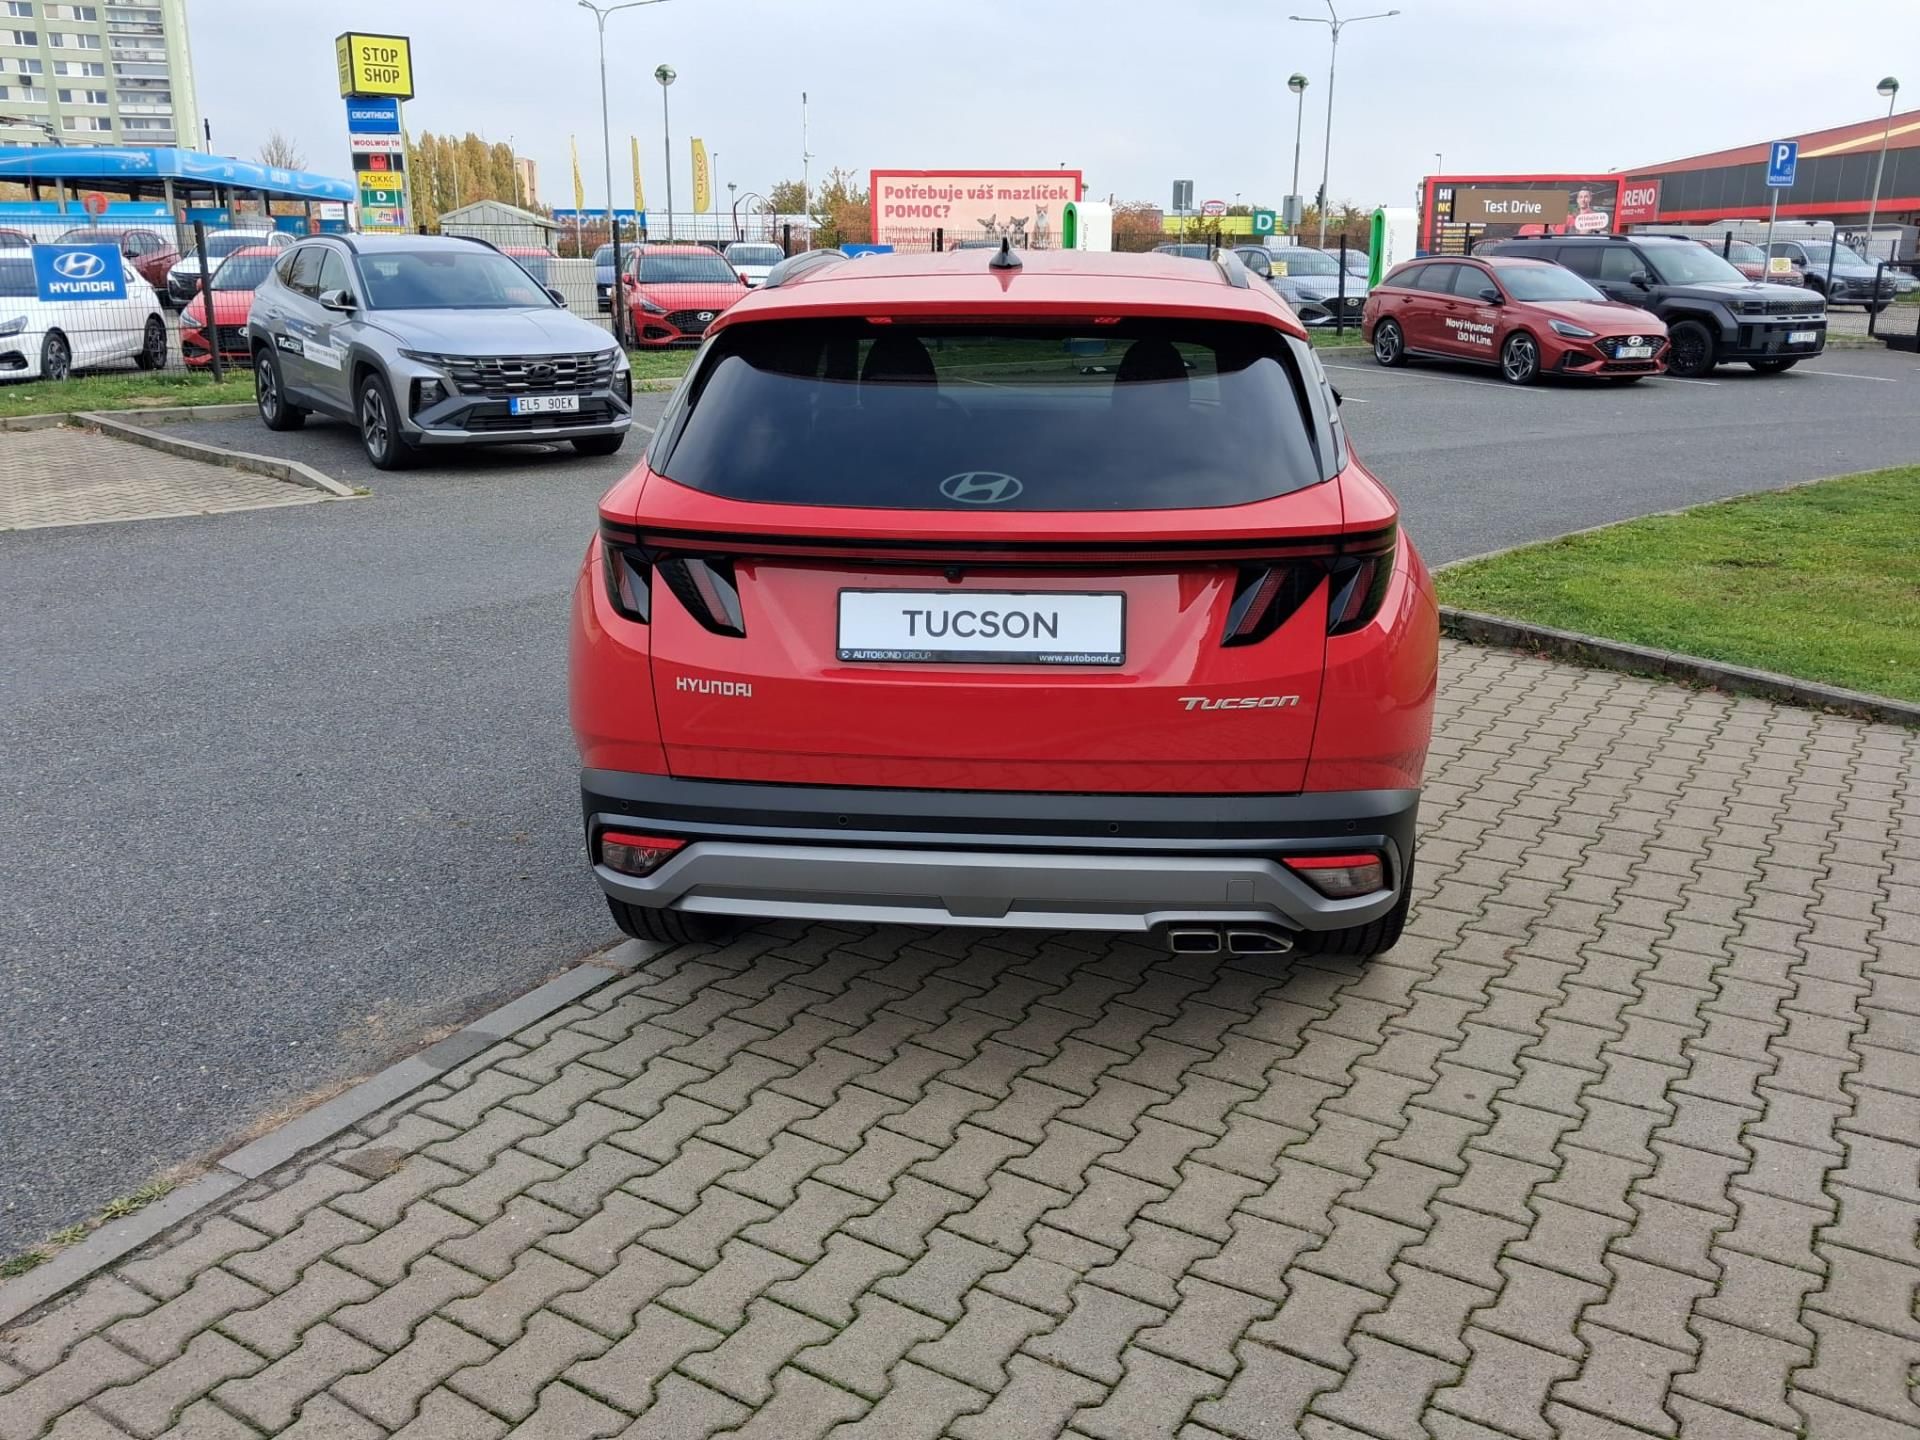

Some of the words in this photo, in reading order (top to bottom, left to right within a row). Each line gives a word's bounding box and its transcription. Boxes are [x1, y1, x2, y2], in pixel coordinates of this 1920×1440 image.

[362, 46, 399, 63] STOP
[364, 67, 400, 83] SHOP
[351, 111, 394, 119] DECATHLON
[1776, 144, 1790, 170] P
[376, 191, 387, 201] D
[884, 184, 963, 203] Potřebuje
[967, 184, 994, 200] váš
[998, 185, 1068, 200] mazlíček
[1622, 188, 1656, 206] RENO
[884, 204, 951, 218] POMOC?
[1484, 200, 1507, 213] Test
[1511, 200, 1542, 213] Drive
[1256, 214, 1273, 230] D
[49, 281, 115, 293] HYUNDAI
[1446, 318, 1464, 330] Nový
[1464, 321, 1494, 333] Hyundai
[1457, 331, 1468, 341] i30
[1469, 335, 1475, 343] N
[520, 399, 540, 411] EL5
[548, 397, 573, 409] 90EK
[902, 609, 1058, 639] TUCSON
[853, 650, 901, 660] AUTOBOND
[903, 651, 932, 660] GROUP
[1038, 654, 1121, 664] www.autobond.cz
[676, 676, 752, 697] HYUNDAI
